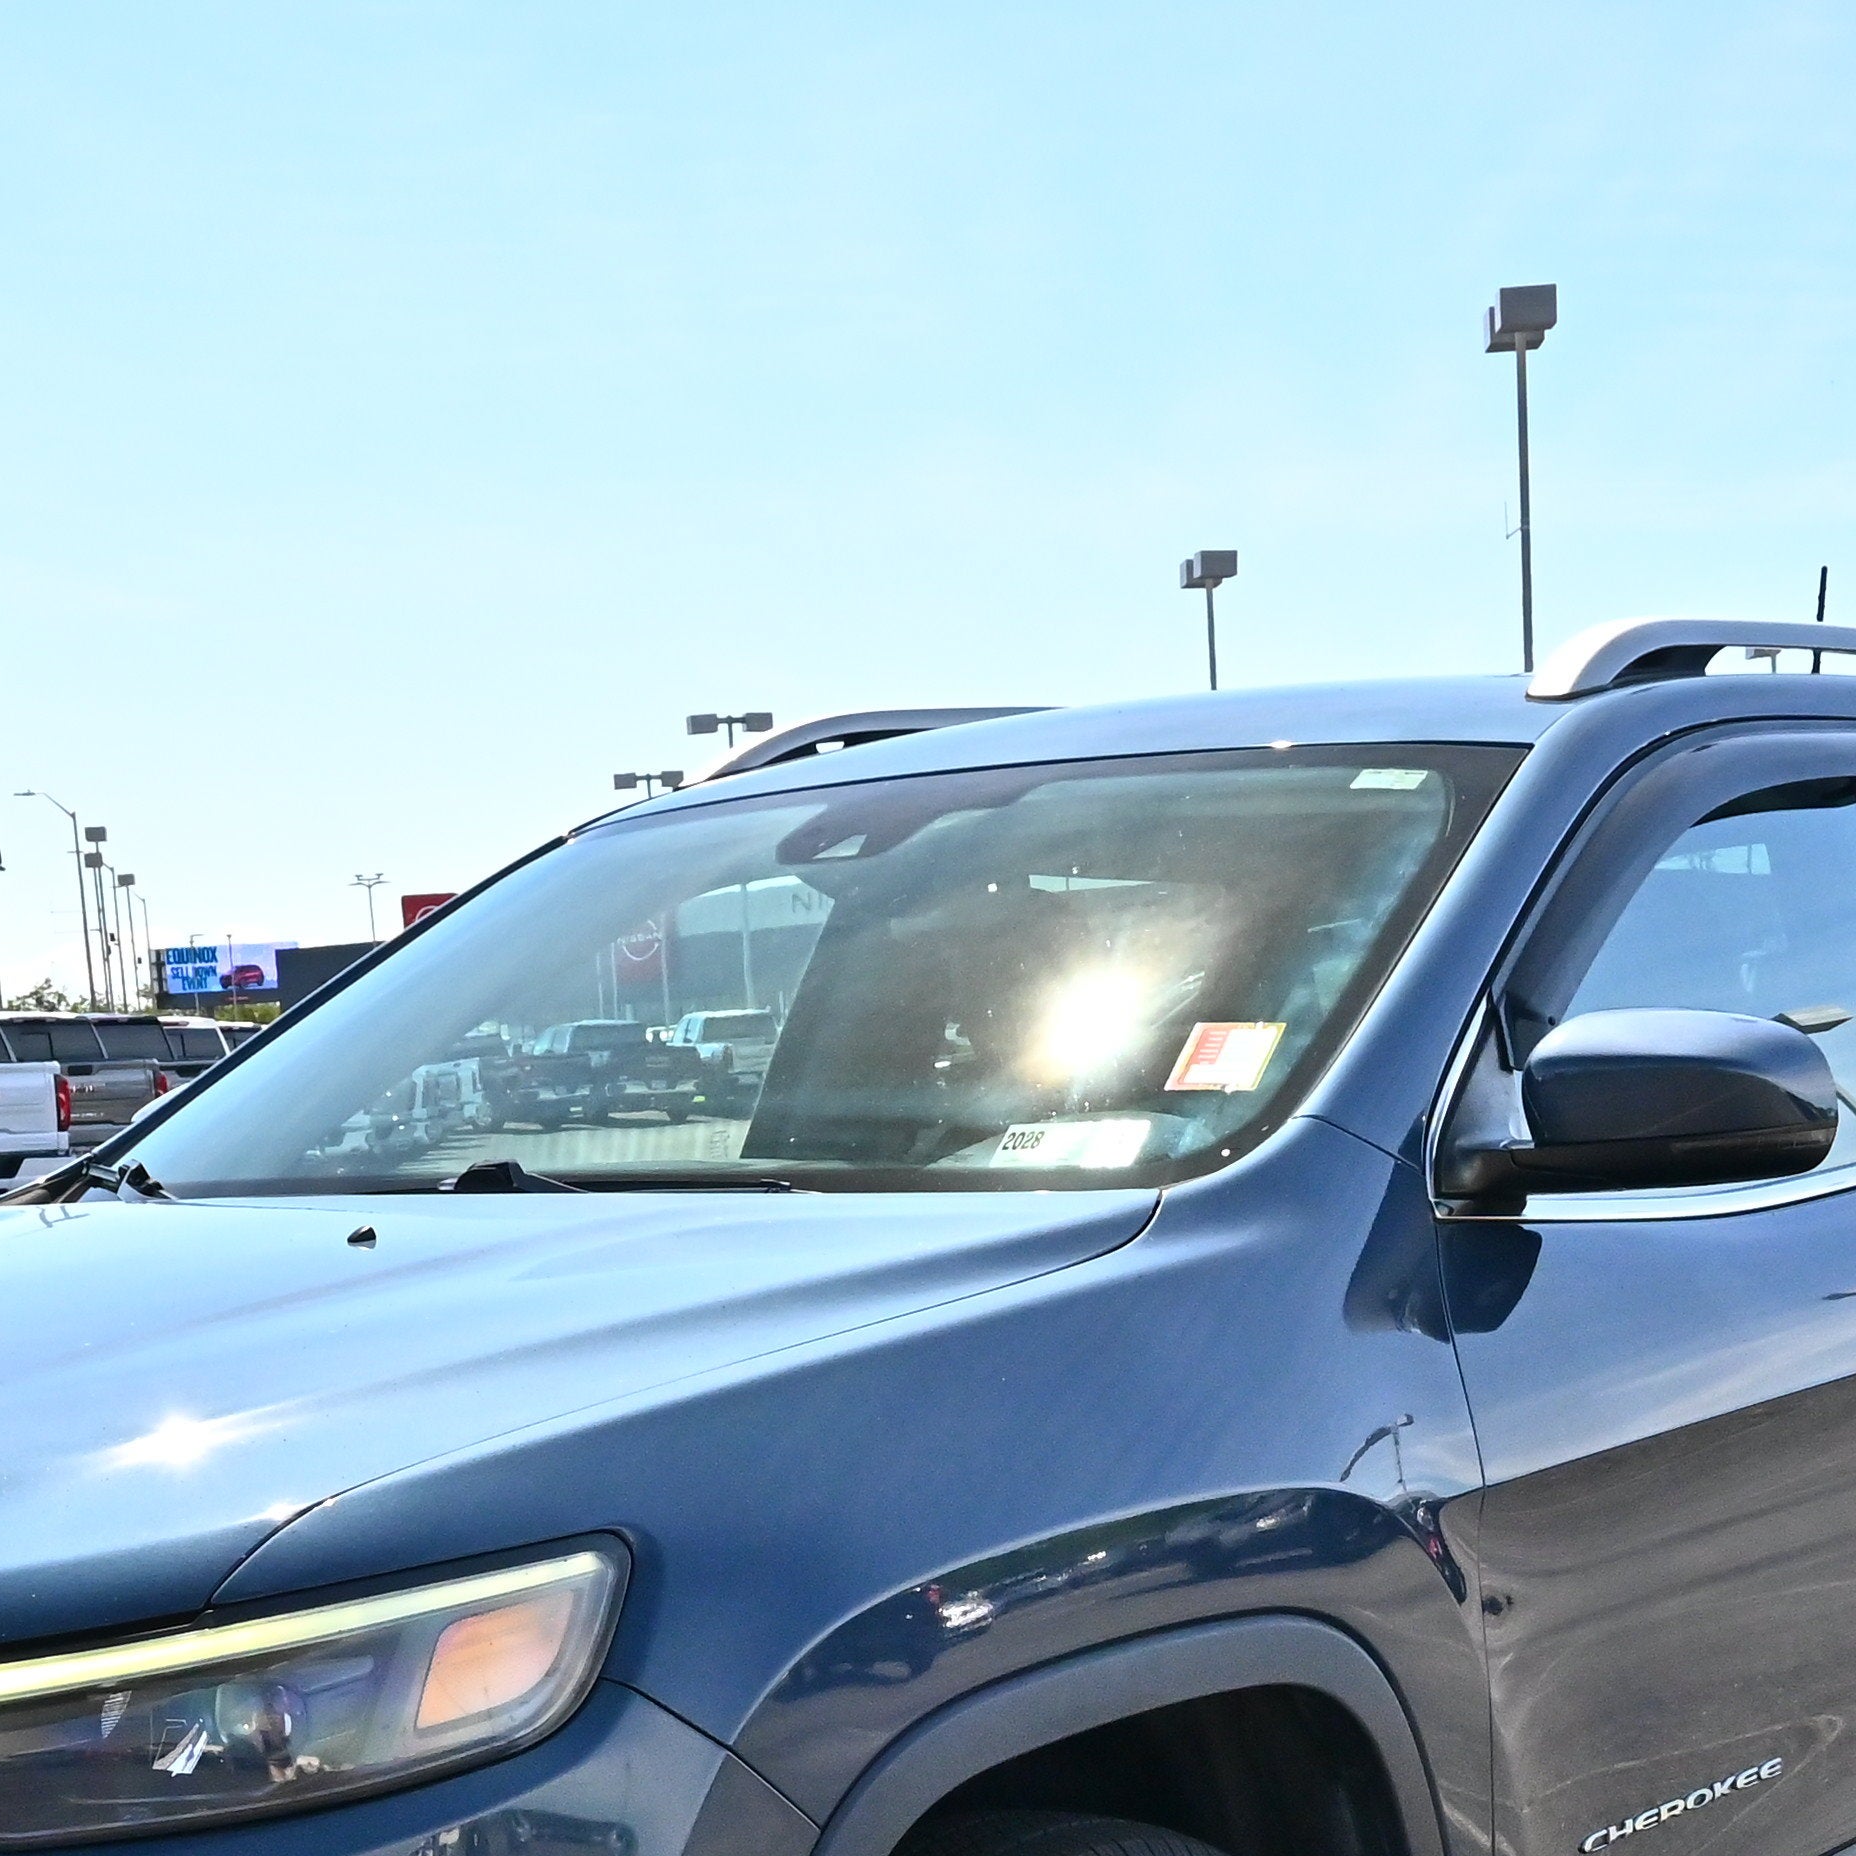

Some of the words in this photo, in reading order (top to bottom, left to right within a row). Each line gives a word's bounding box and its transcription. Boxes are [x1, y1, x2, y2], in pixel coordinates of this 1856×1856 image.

[167, 946, 218, 964] EQUINOX
[171, 966, 189, 979] SELL
[1002, 1131, 1045, 1150] 2028
[1582, 1757, 1782, 1854] CHEROKEE
